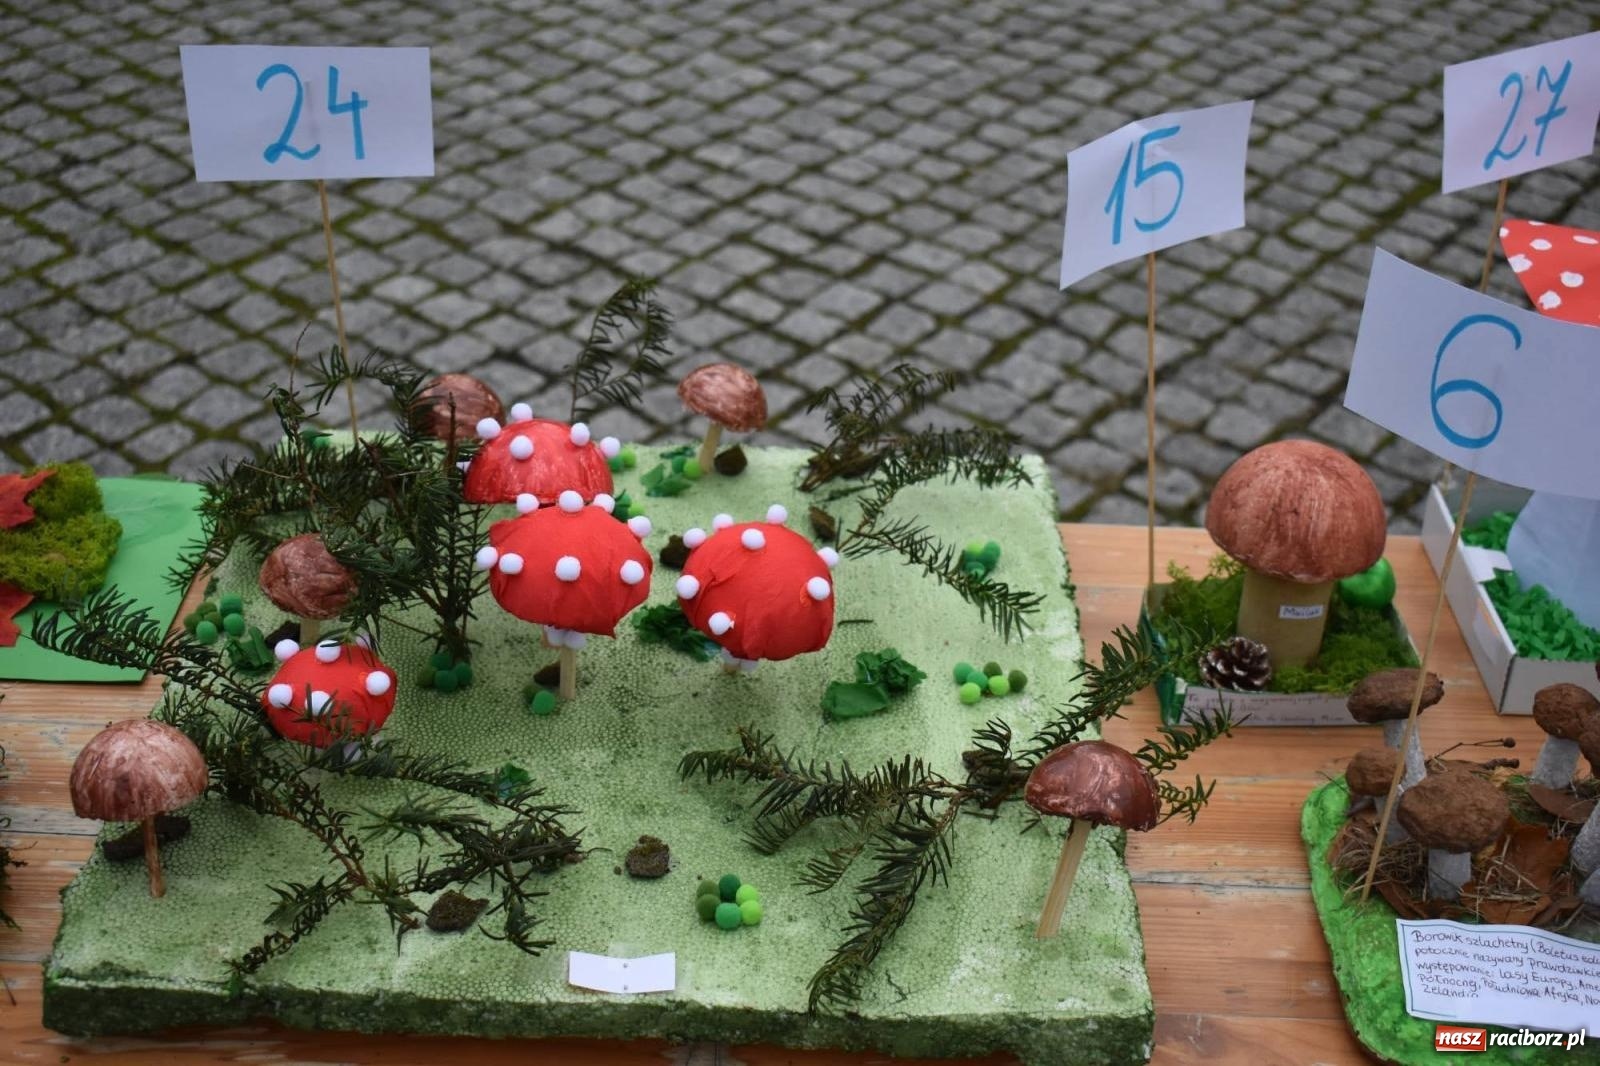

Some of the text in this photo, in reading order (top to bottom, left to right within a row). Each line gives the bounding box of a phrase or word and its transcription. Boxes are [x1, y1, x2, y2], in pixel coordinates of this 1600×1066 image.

[256, 63, 368, 164] 24
[1483, 59, 1573, 170] 27
[1104, 125, 1184, 245] 15
[1430, 314, 1523, 449] 6
[1411, 930, 1463, 943] Borowik
[1415, 945, 1469, 957] potocznie
[1473, 953, 1524, 967] nazywany
[1499, 968, 1529, 985] lasy
